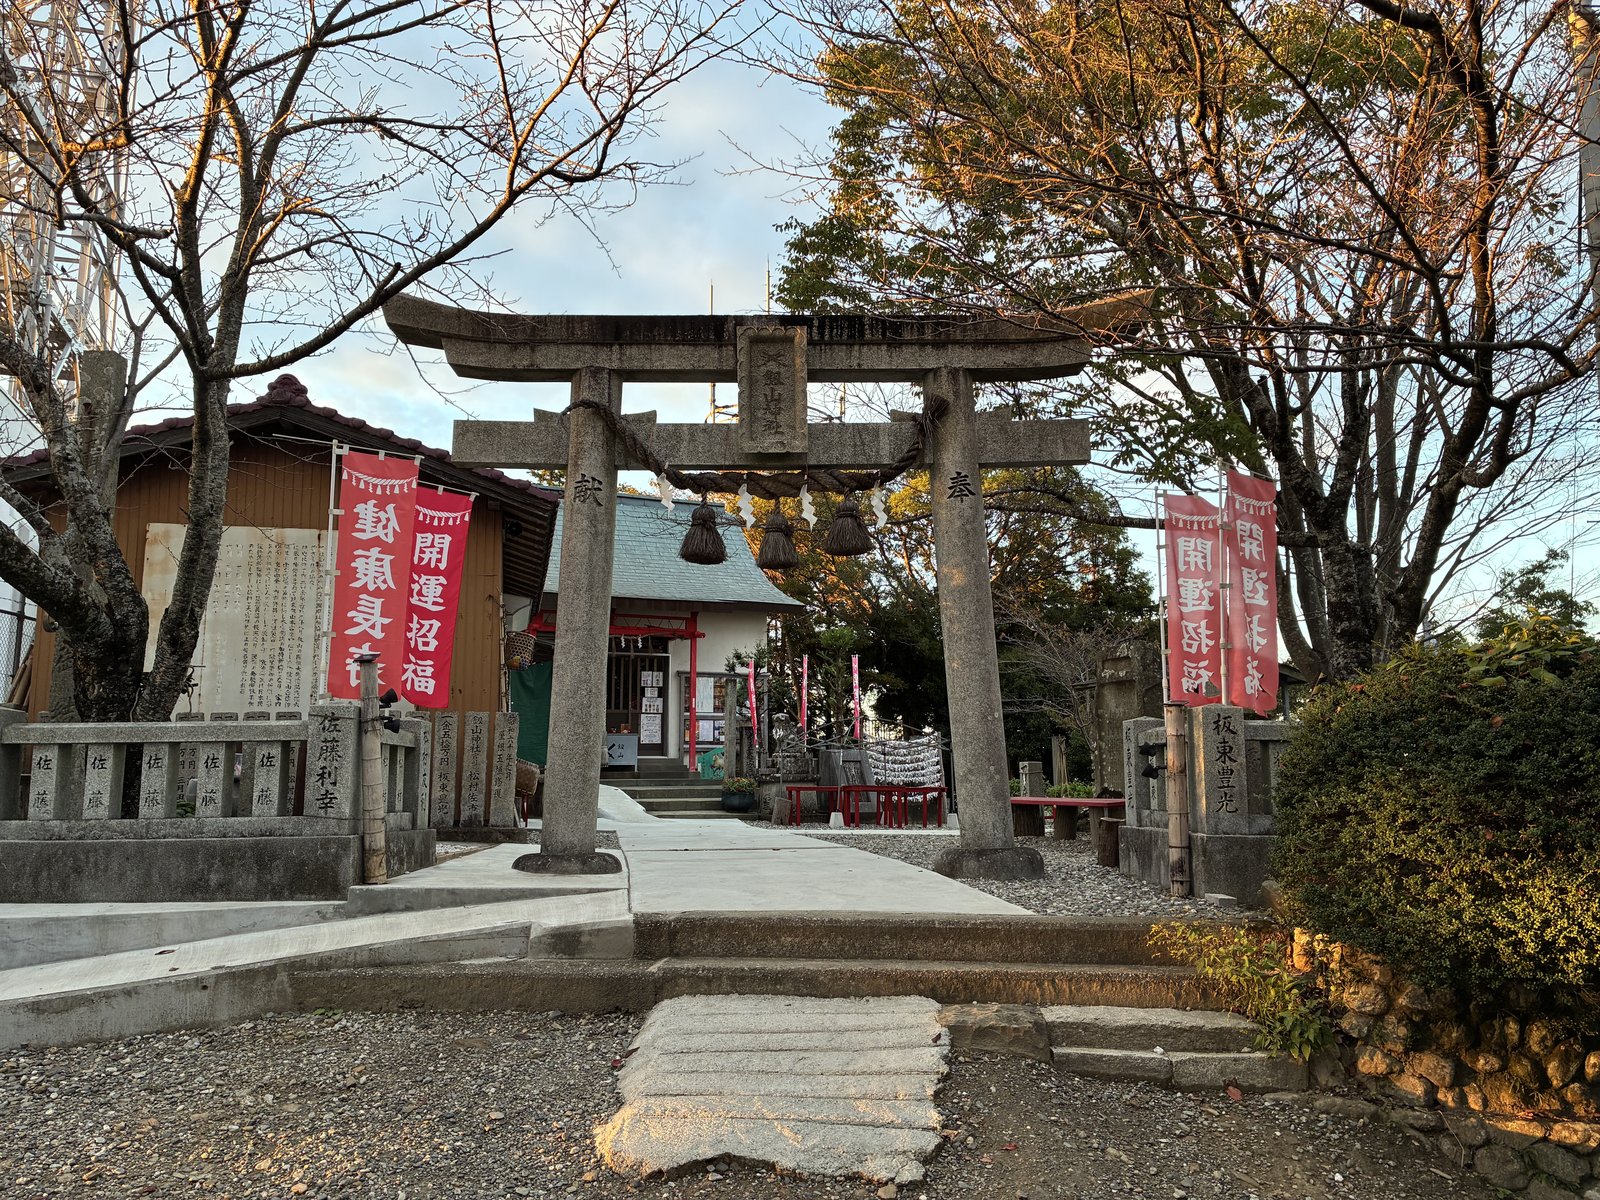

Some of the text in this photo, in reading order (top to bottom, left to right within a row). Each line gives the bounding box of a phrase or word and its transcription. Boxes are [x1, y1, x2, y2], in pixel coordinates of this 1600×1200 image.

[947, 471, 977, 504] 奉
[402, 532, 453, 695] 開運招福
[33, 755, 53, 809] 佐藤
[87, 755, 108, 809] 佐藤
[144, 754, 164, 807] 佐藤
[201, 753, 222, 808] 佐藤
[257, 751, 277, 808] 佐藤
[316, 711, 343, 811] 佐藤利幸
[1212, 712, 1239, 815] 板東豊光
